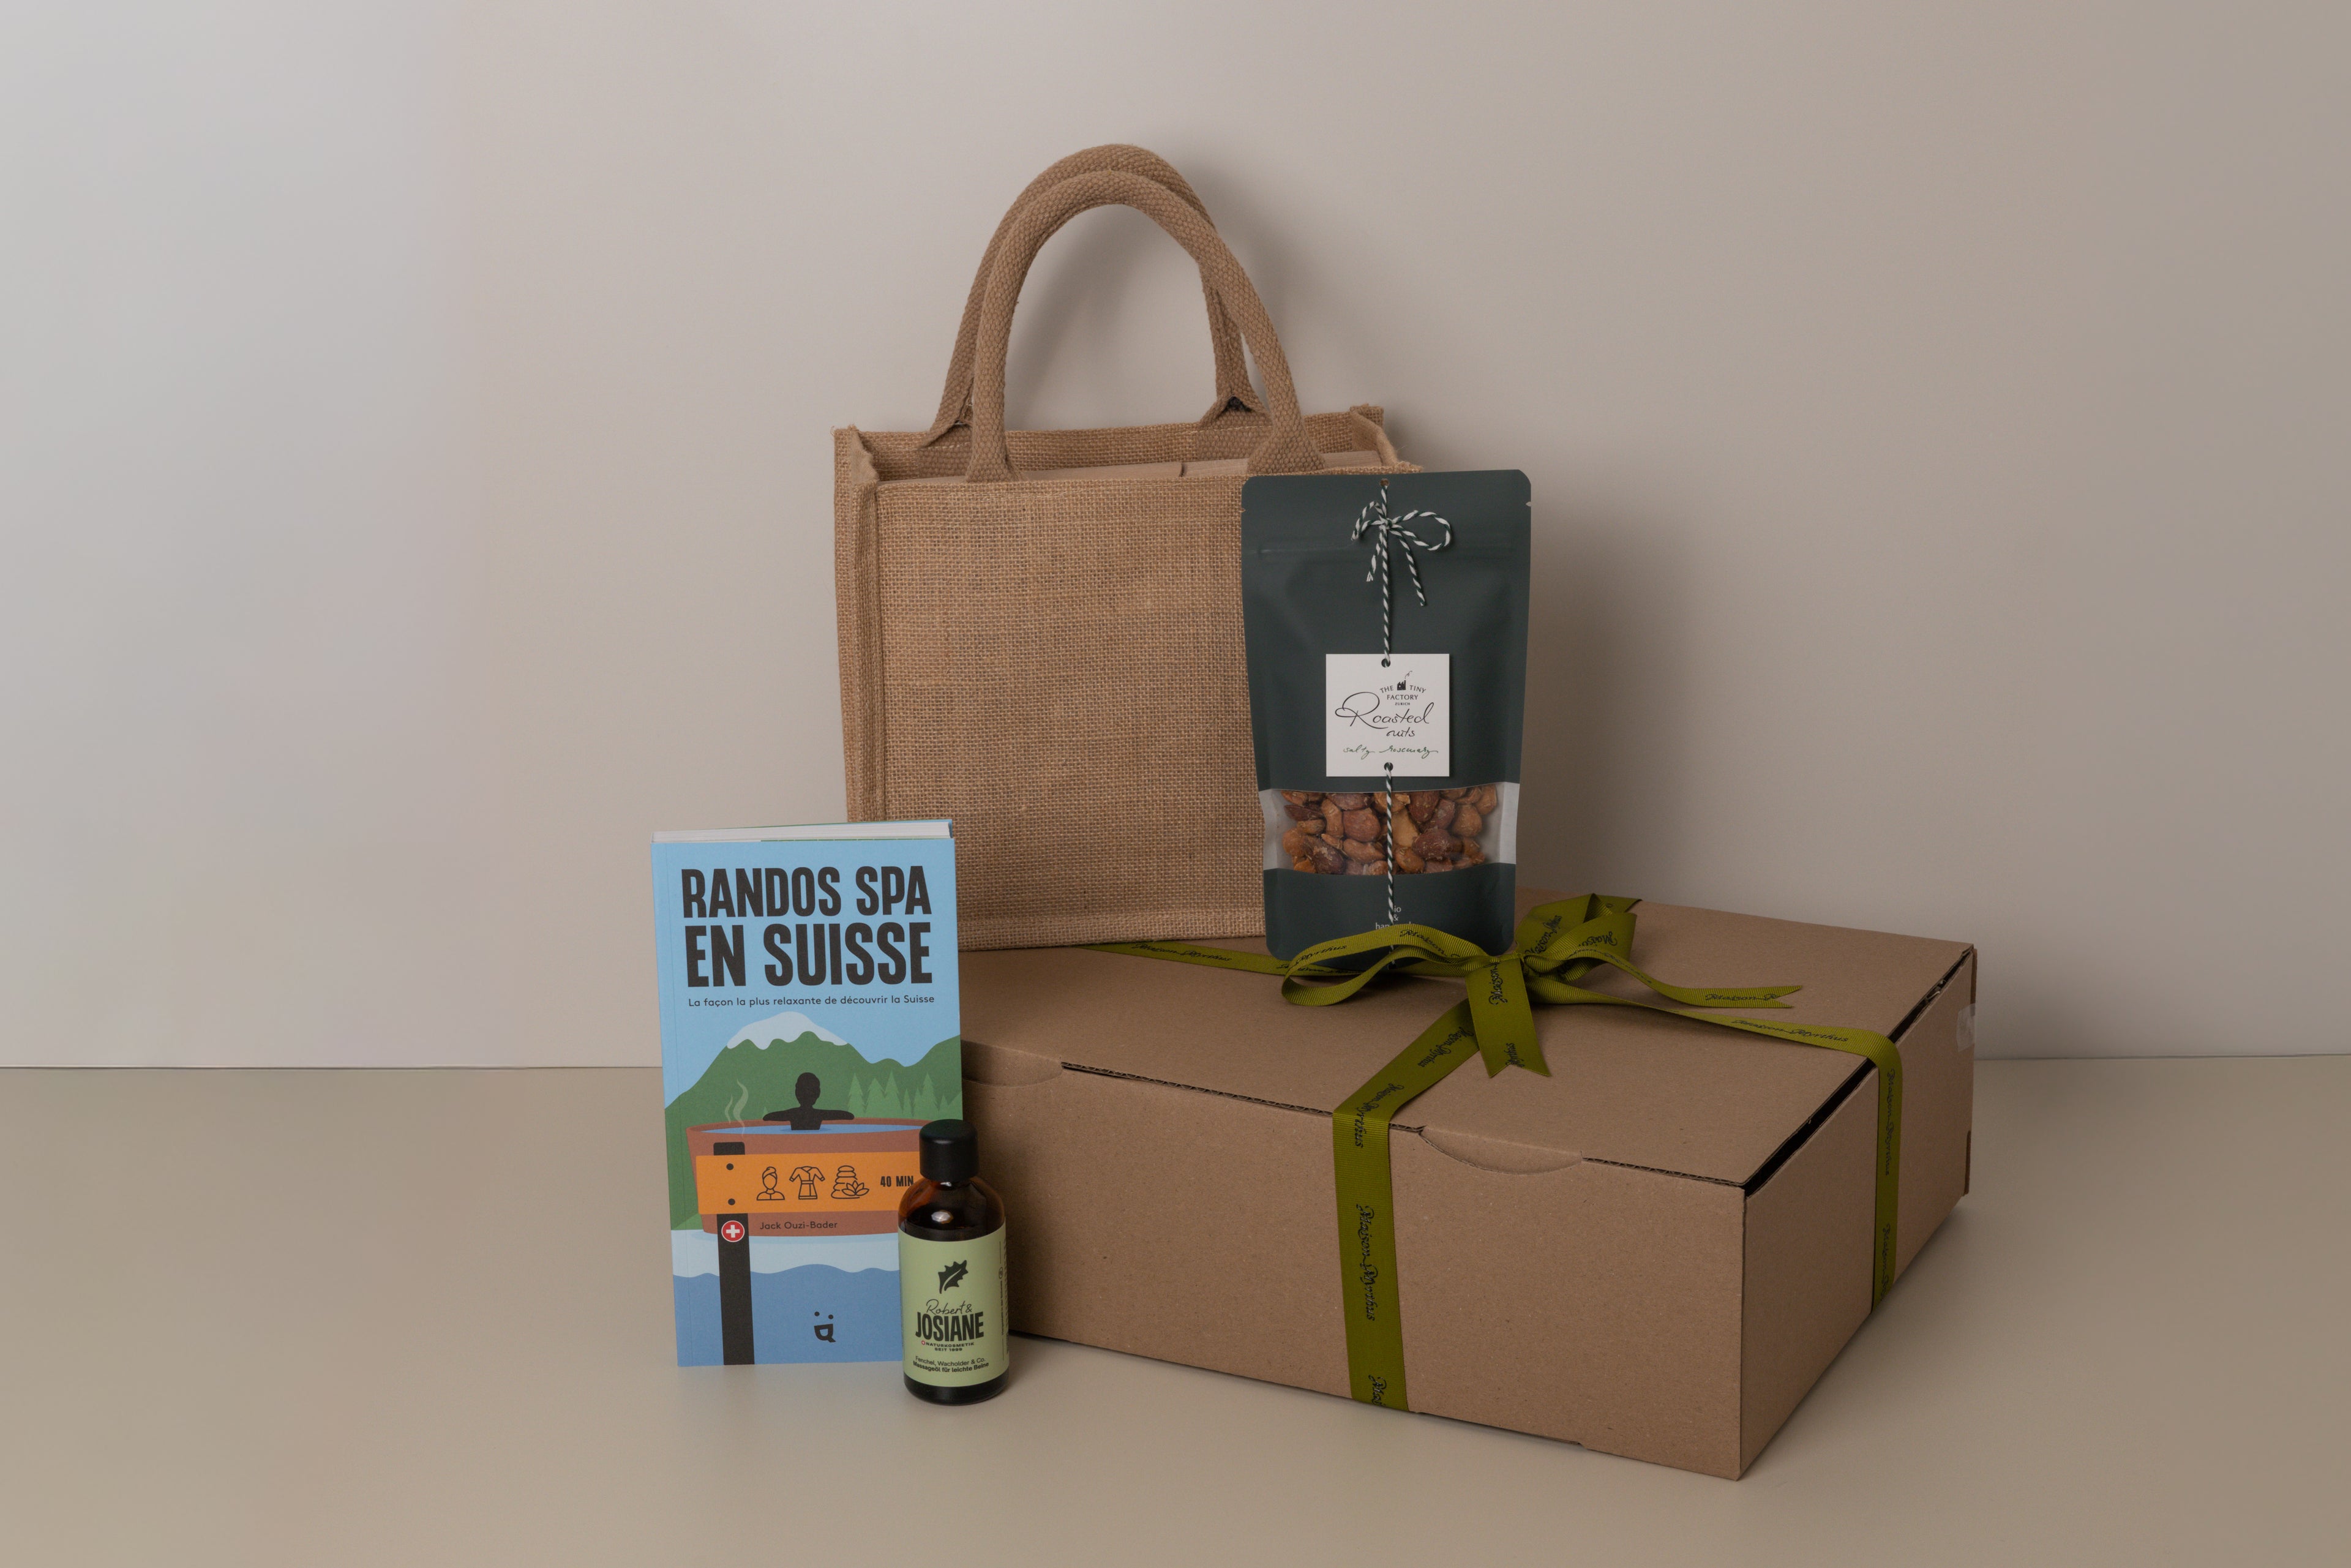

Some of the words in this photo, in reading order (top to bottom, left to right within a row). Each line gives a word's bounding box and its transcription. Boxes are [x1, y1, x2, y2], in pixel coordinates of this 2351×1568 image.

[1409, 685, 1427, 694] TINY
[1335, 691, 1434, 729] Roasted
[1385, 727, 1415, 737] nuts
[1343, 744, 1376, 760] salty
[1379, 745, 1439, 759] rosemary
[681, 866, 841, 918] RANDOS
[855, 865, 932, 916] SPA
[684, 925, 746, 988] EN
[763, 921, 933, 987] SUISSE
[688, 999, 700, 1007] La
[703, 998, 733, 1008] façon
[736, 997, 746, 1006] la
[749, 997, 770, 1008] plus
[773, 996, 821, 1005] relaxante
[824, 996, 837, 1005] de
[840, 996, 888, 1005] découvrir
[891, 995, 901, 1003] la
[903, 995, 935, 1004] Suisse
[880, 1176, 893, 1187] 40
[896, 1175, 914, 1187] MIN
[759, 1221, 781, 1230] Jack
[784, 1220, 838, 1230] Ouzi-Bader
[926, 1299, 966, 1315] Robert
[966, 1304, 973, 1313] &
[915, 1311, 984, 1342] JOSIANE
[912, 1360, 941, 1372] Massageöl
[973, 1361, 989, 1370] Beine
[915, 1356, 936, 1366] Fenchel,
